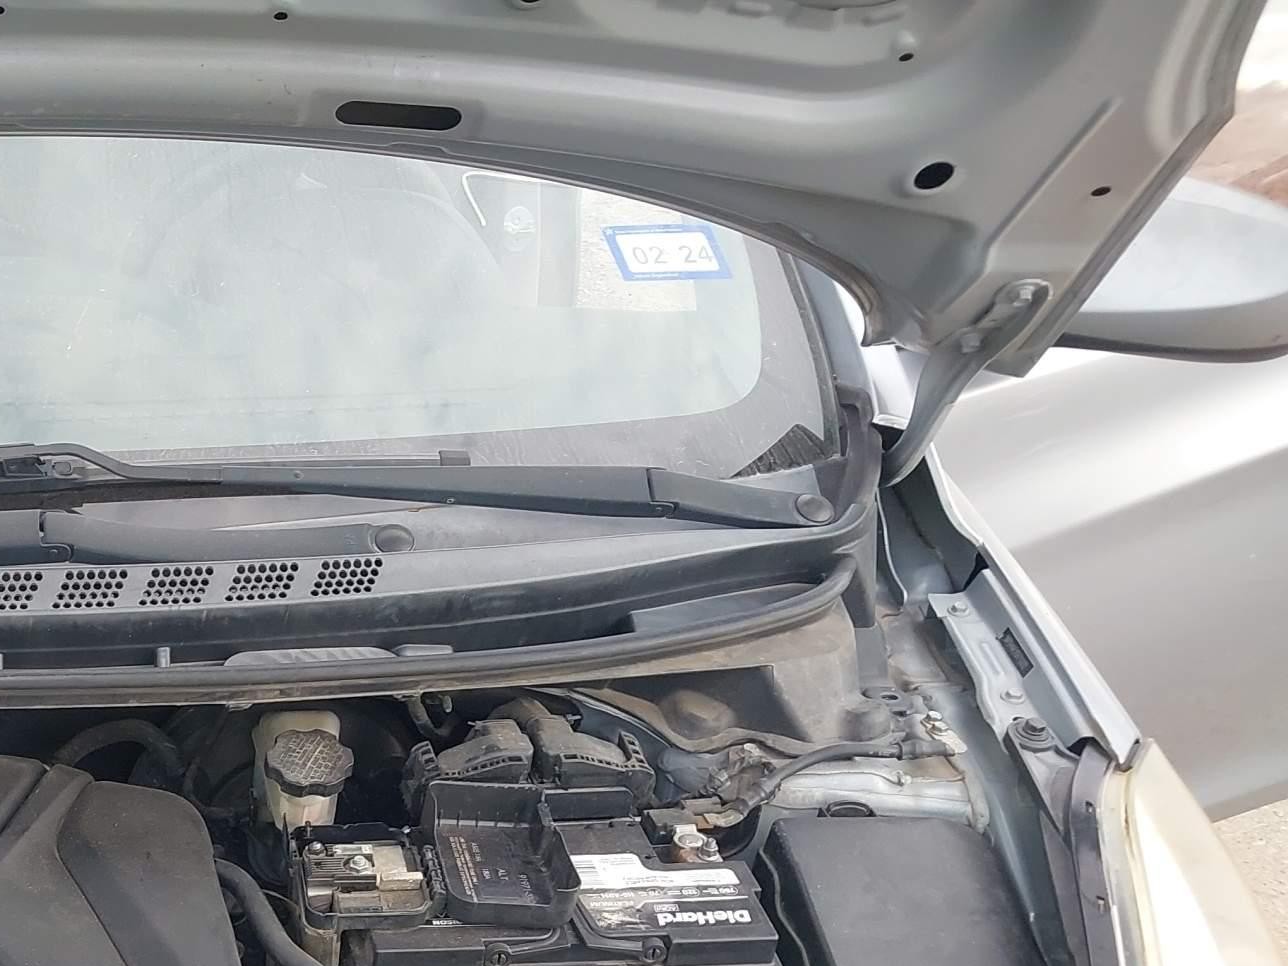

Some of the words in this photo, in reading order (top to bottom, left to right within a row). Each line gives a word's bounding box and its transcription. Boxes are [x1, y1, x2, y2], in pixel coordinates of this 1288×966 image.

[631, 246, 667, 265] 02
[678, 245, 714, 264] 24
[657, 909, 752, 926] DieHard
